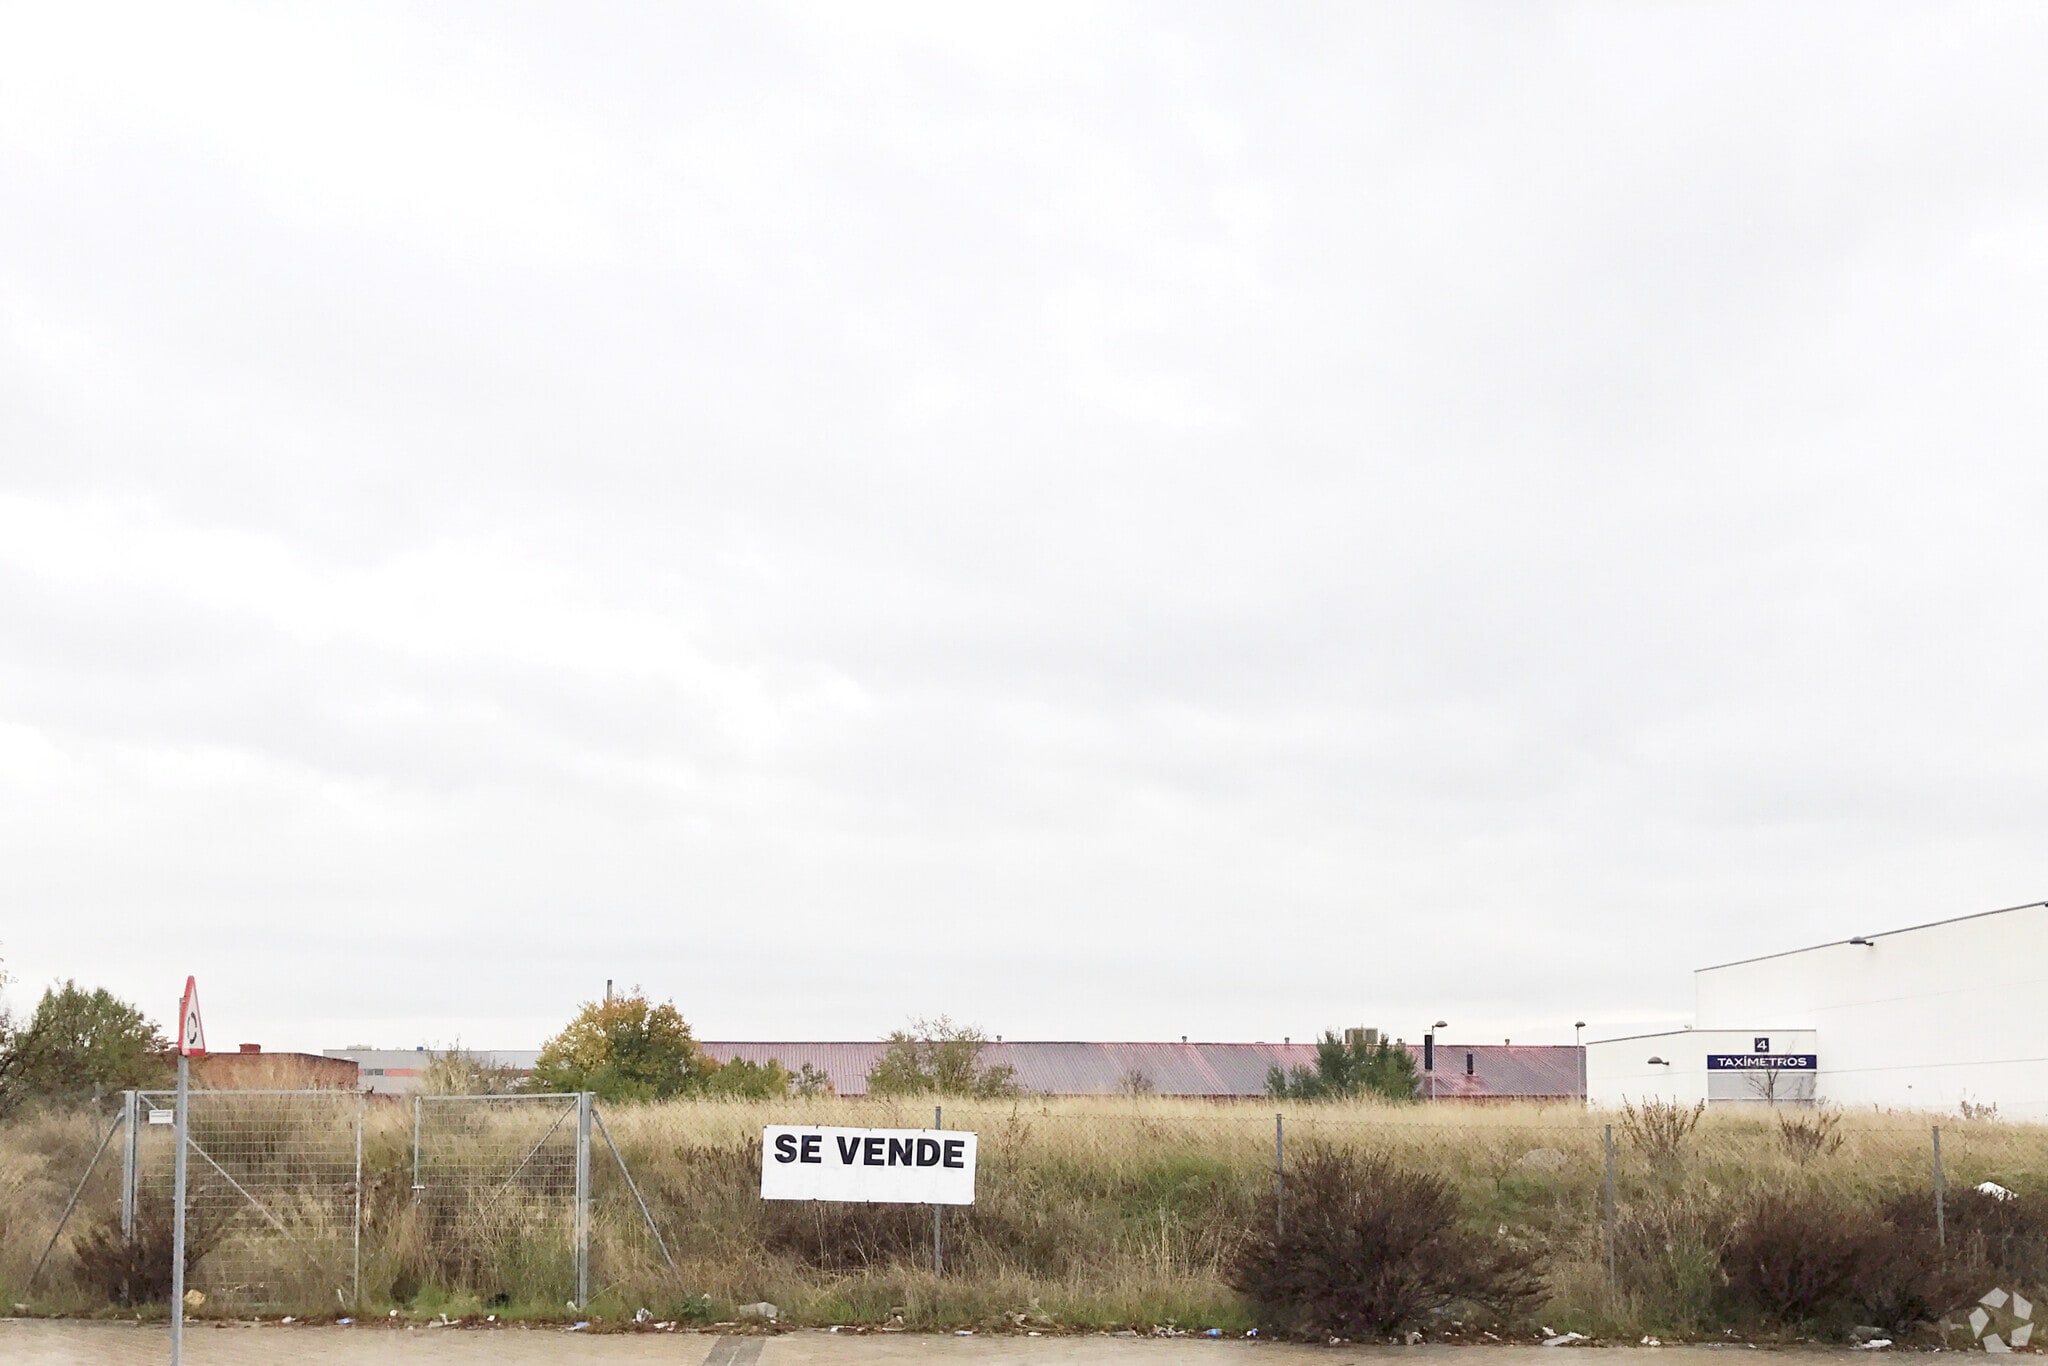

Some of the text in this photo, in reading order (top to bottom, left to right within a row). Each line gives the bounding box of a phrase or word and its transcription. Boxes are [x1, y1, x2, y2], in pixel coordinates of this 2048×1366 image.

[1757, 1040, 1768, 1050] 4
[1717, 1055, 1807, 1067] TAXÍMETROS
[774, 1134, 965, 1169] SE VENDE
